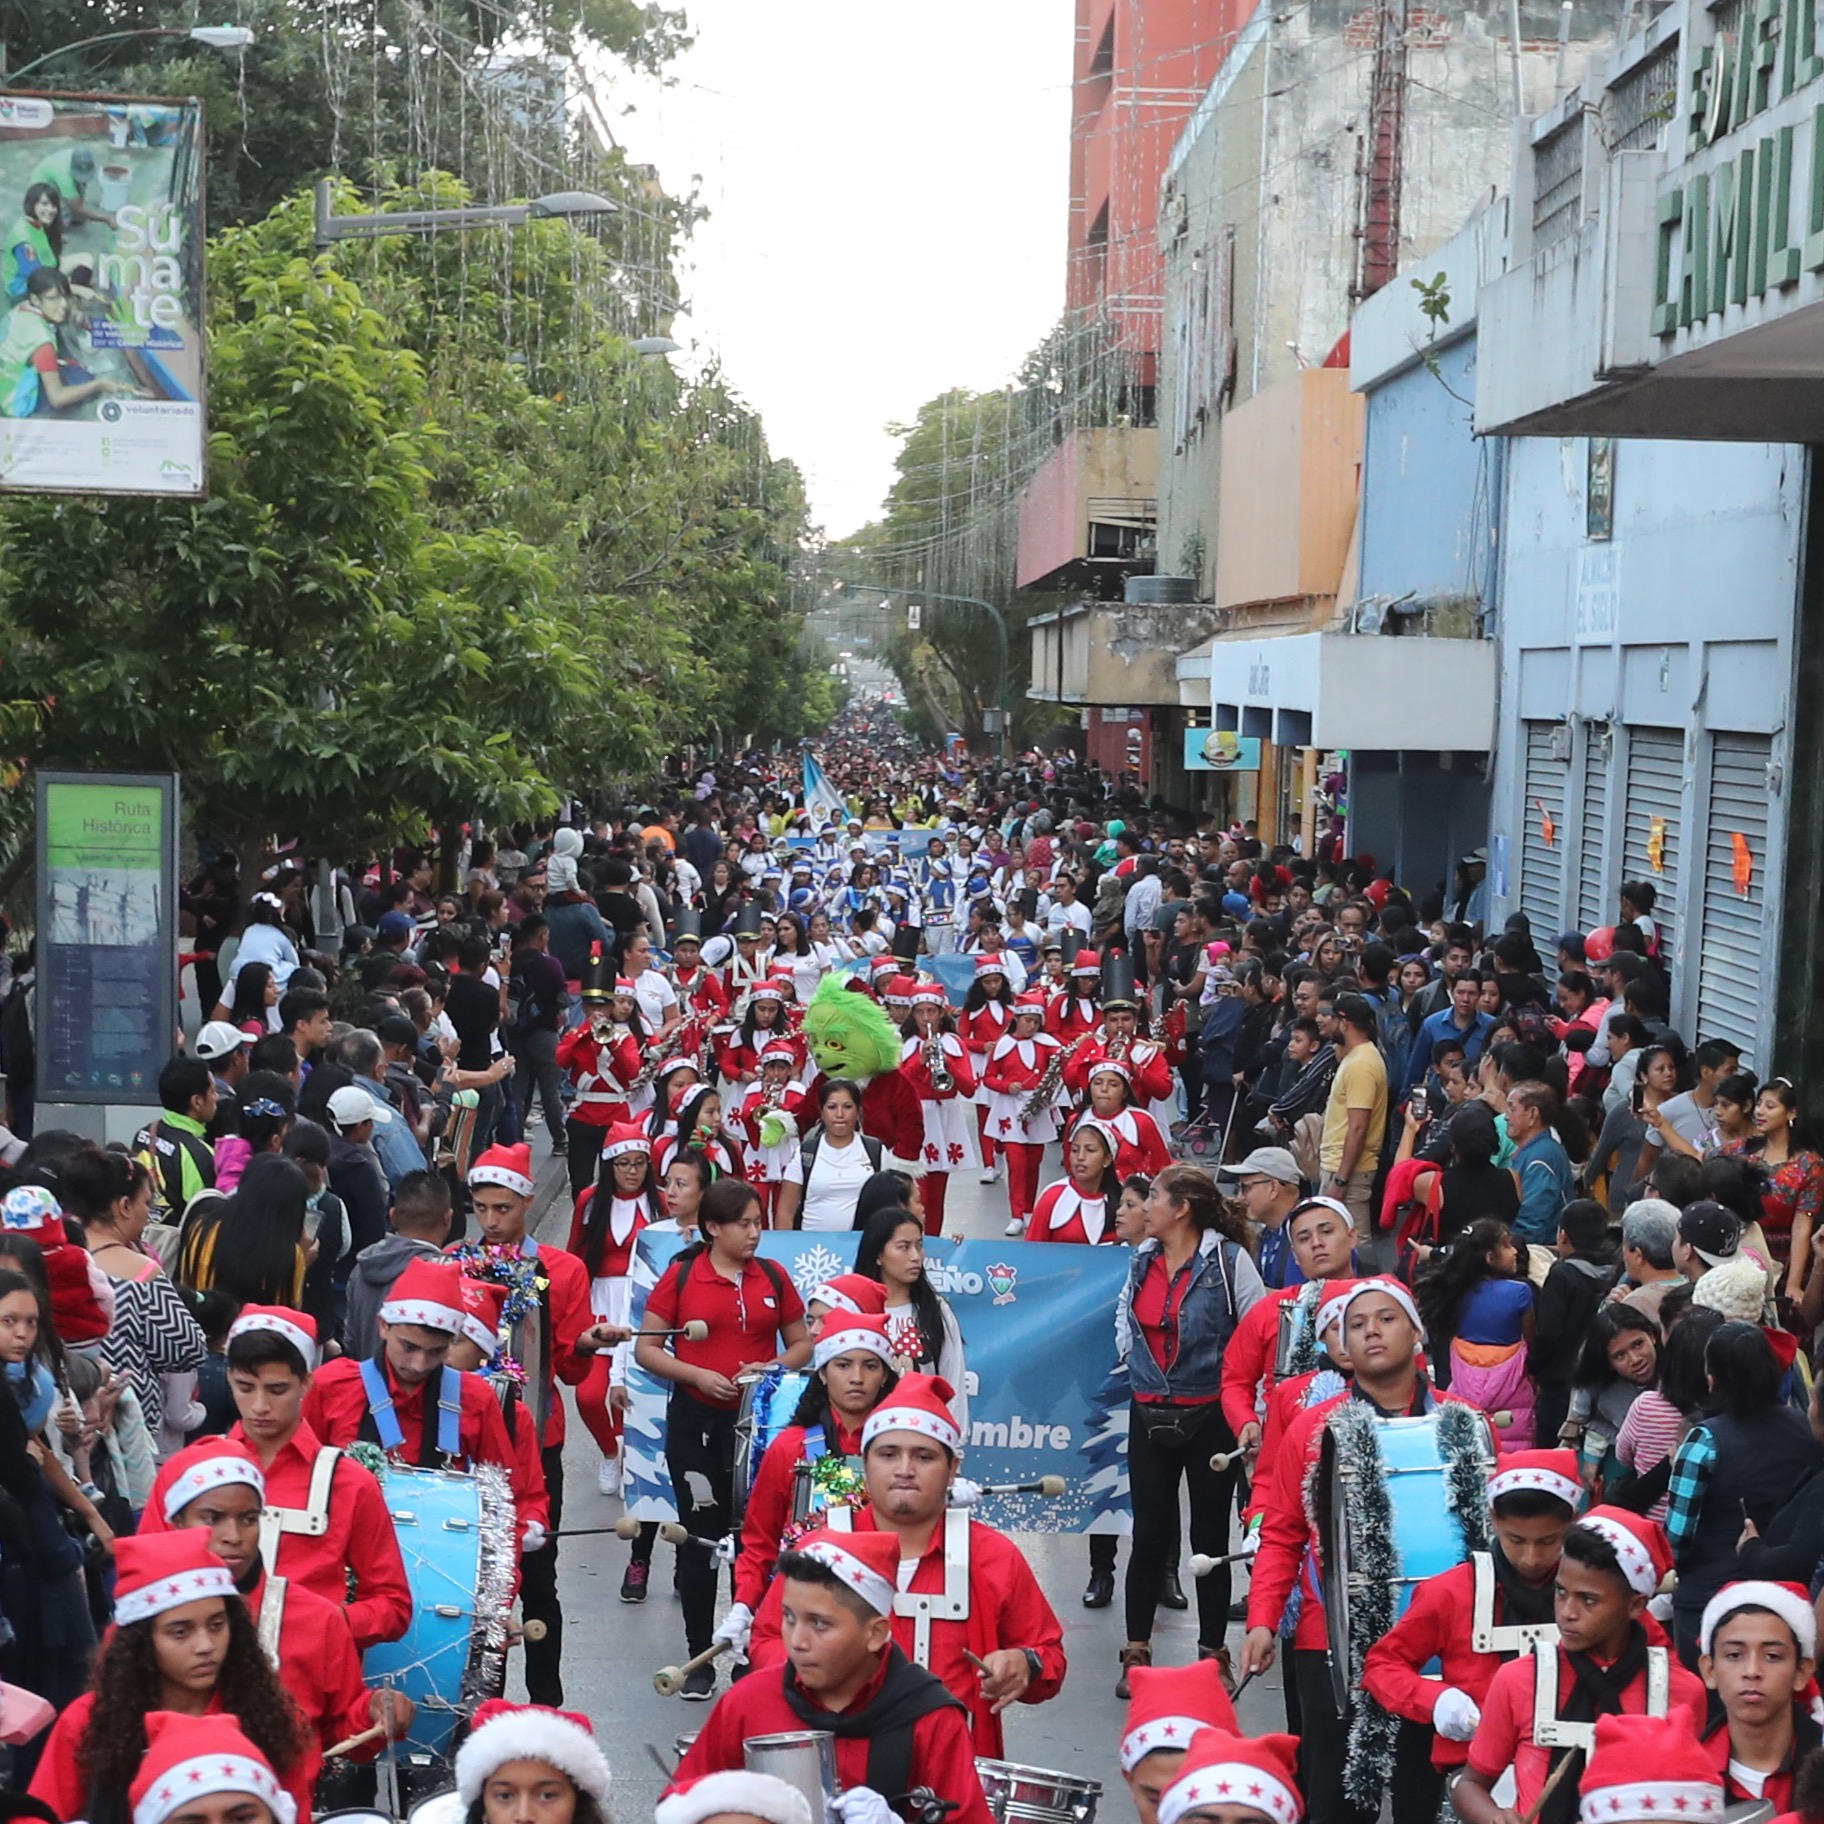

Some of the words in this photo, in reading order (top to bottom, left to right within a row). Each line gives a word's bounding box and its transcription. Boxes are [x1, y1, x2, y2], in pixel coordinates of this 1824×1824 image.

[114, 801, 152, 817] Ruta
[82, 818, 152, 836] Histórica
[965, 1415, 1072, 1450] mbre
